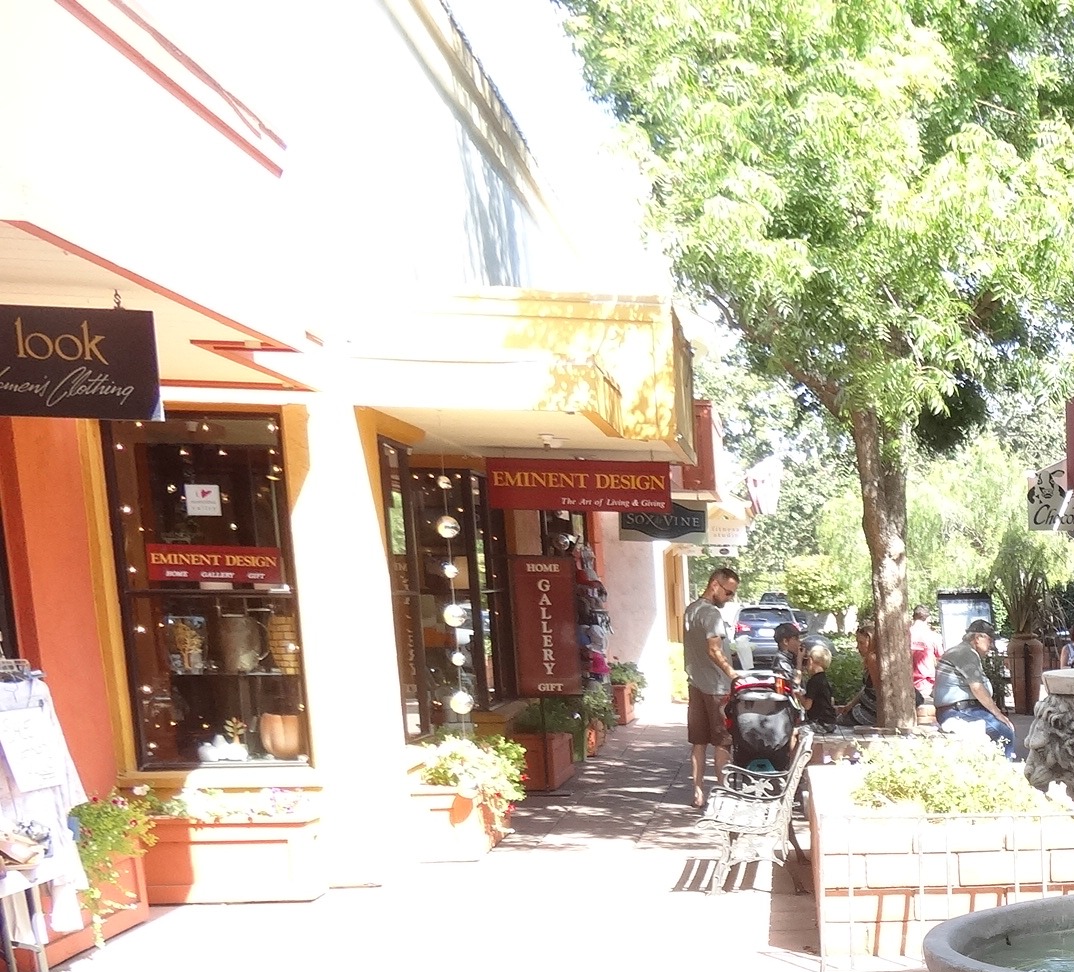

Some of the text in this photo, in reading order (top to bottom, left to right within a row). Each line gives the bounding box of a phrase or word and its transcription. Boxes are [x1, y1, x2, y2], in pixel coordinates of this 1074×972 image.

[15, 316, 109, 366] look
[46, 366, 135, 407] Clothing
[491, 470, 666, 491] EMINENT DESIGN
[561, 497, 666, 509] The Art of Living & Giving
[150, 552, 278, 568] EMINENT DESIGN
[526, 563, 560, 573] HOME
[200, 571, 235, 579] GALLERY
[537, 579, 556, 675] GALLERY
[537, 683, 564, 692] GIFT
